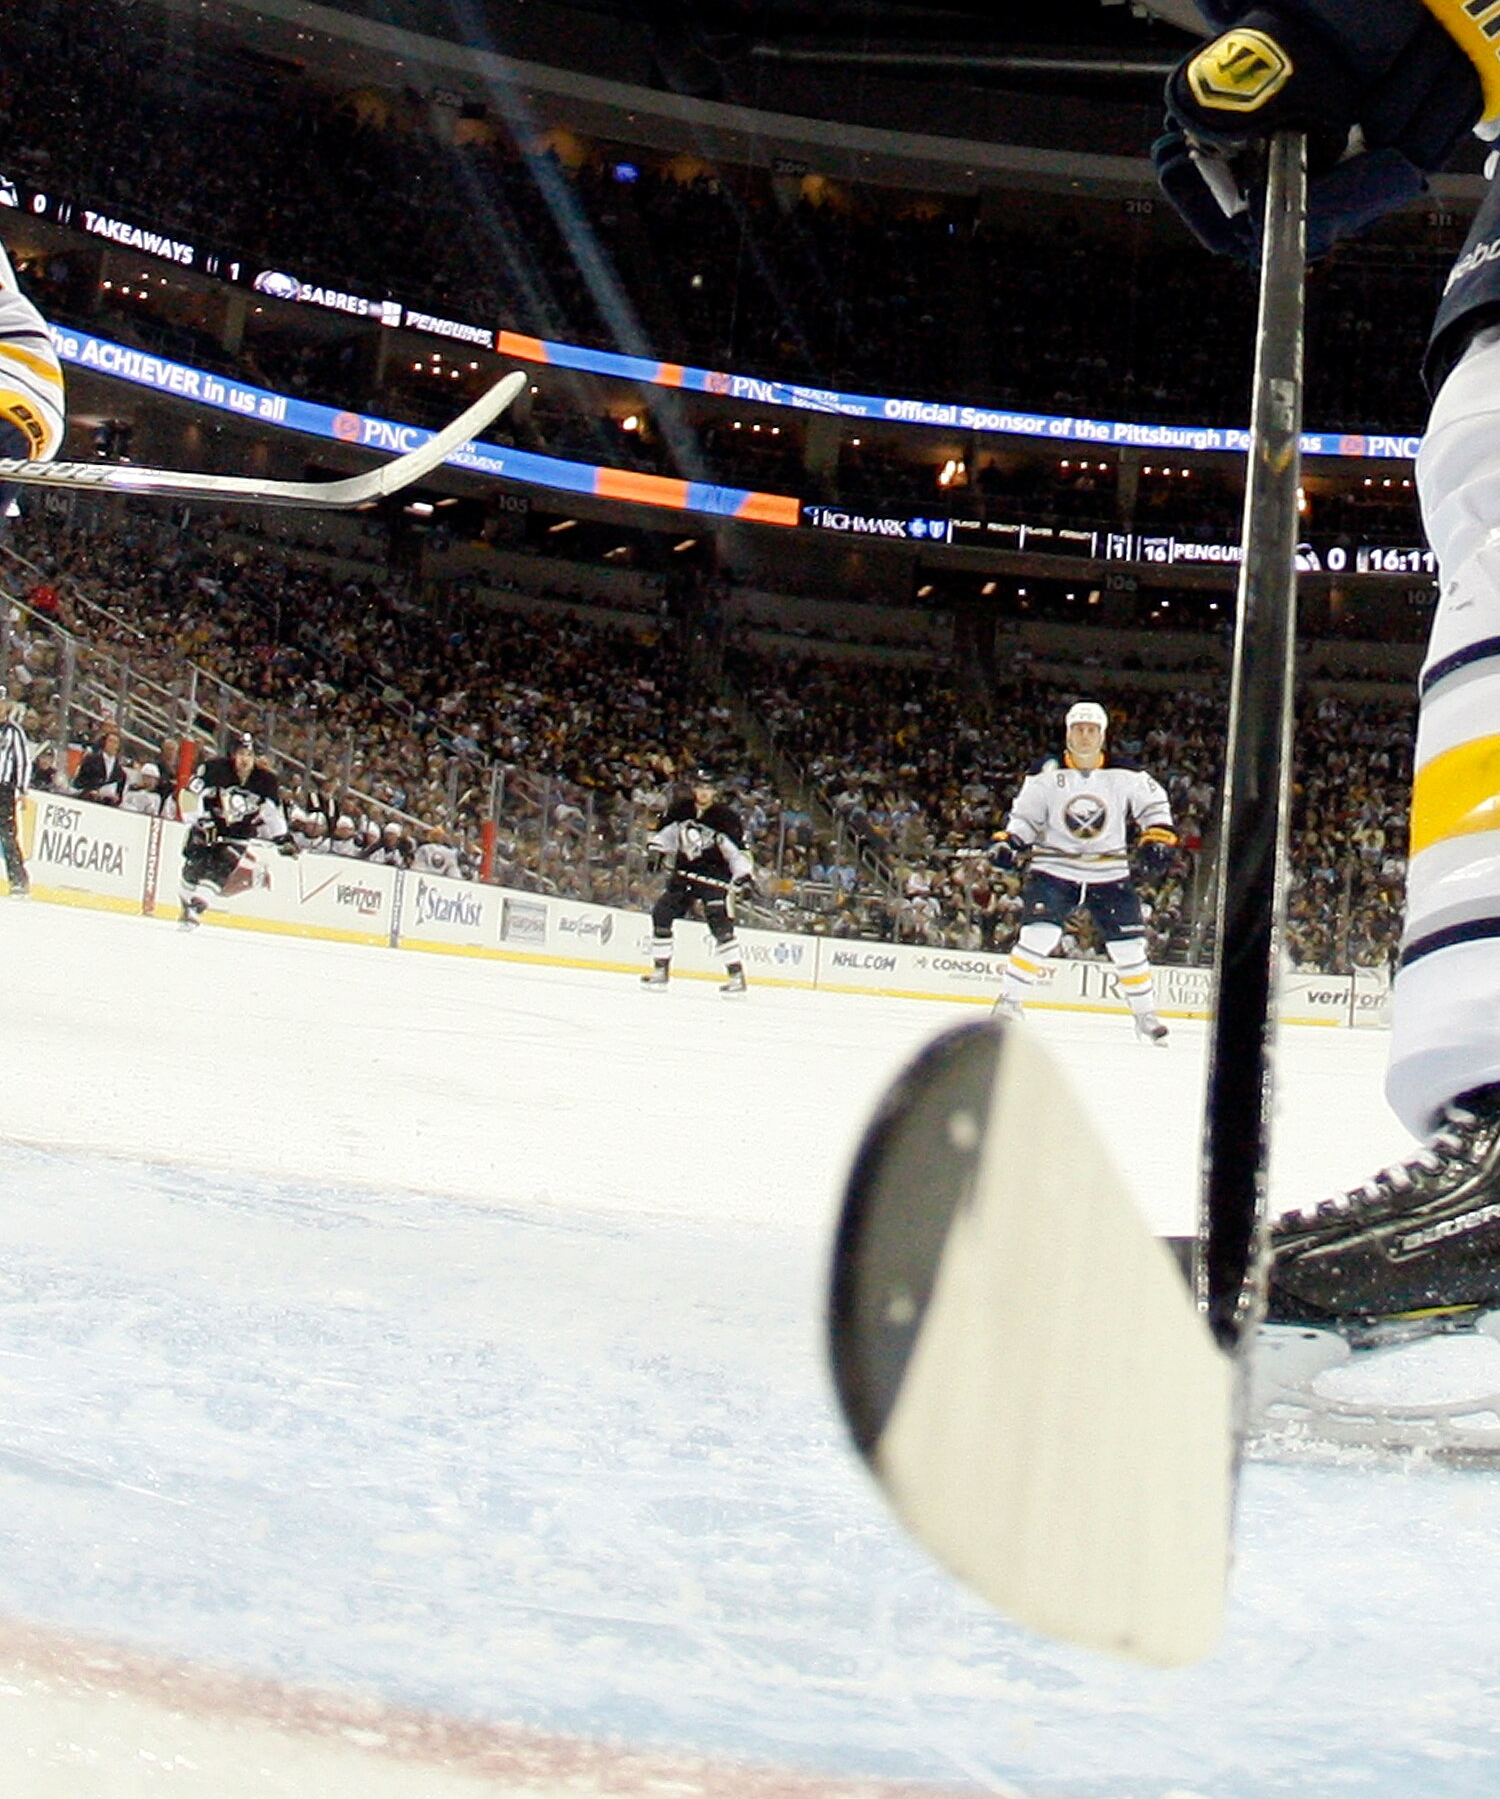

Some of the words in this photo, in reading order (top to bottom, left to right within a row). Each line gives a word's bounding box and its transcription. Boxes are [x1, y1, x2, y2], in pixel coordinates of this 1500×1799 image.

[33, 194, 47, 214] 0
[83, 210, 195, 265] TAKEAWAYS
[229, 261, 241, 281] 1
[299, 284, 369, 316] SABRES
[81, 338, 200, 396] ACHIEVER
[204, 376, 225, 404] in
[229, 388, 256, 413] us
[259, 396, 287, 421] all
[363, 418, 419, 452] PNC
[733, 375, 784, 404] PNC
[885, 399, 956, 424] Official
[960, 407, 1047, 433] Sponsor
[1049, 417, 1072, 437] of
[1075, 420, 1110, 440] the
[1114, 424, 1220, 450] Pittsburgh
[1368, 436, 1420, 458] PNC
[812, 508, 907, 538] HIGHMARK
[1113, 543, 1123, 559] 1
[1143, 545, 1166, 562] 16
[1327, 547, 1347, 570] 0
[1370, 548, 1435, 573] 16:11
[44, 804, 82, 832] FIRST
[38, 832, 124, 876] NIAGARA
[336, 880, 382, 914] verizon
[425, 886, 484, 928] StarKist
[832, 951, 897, 972] NHL.COM
[932, 958, 993, 975] CONSOL
[1070, 961, 1121, 999] TR
[1165, 969, 1211, 989] TOTA
